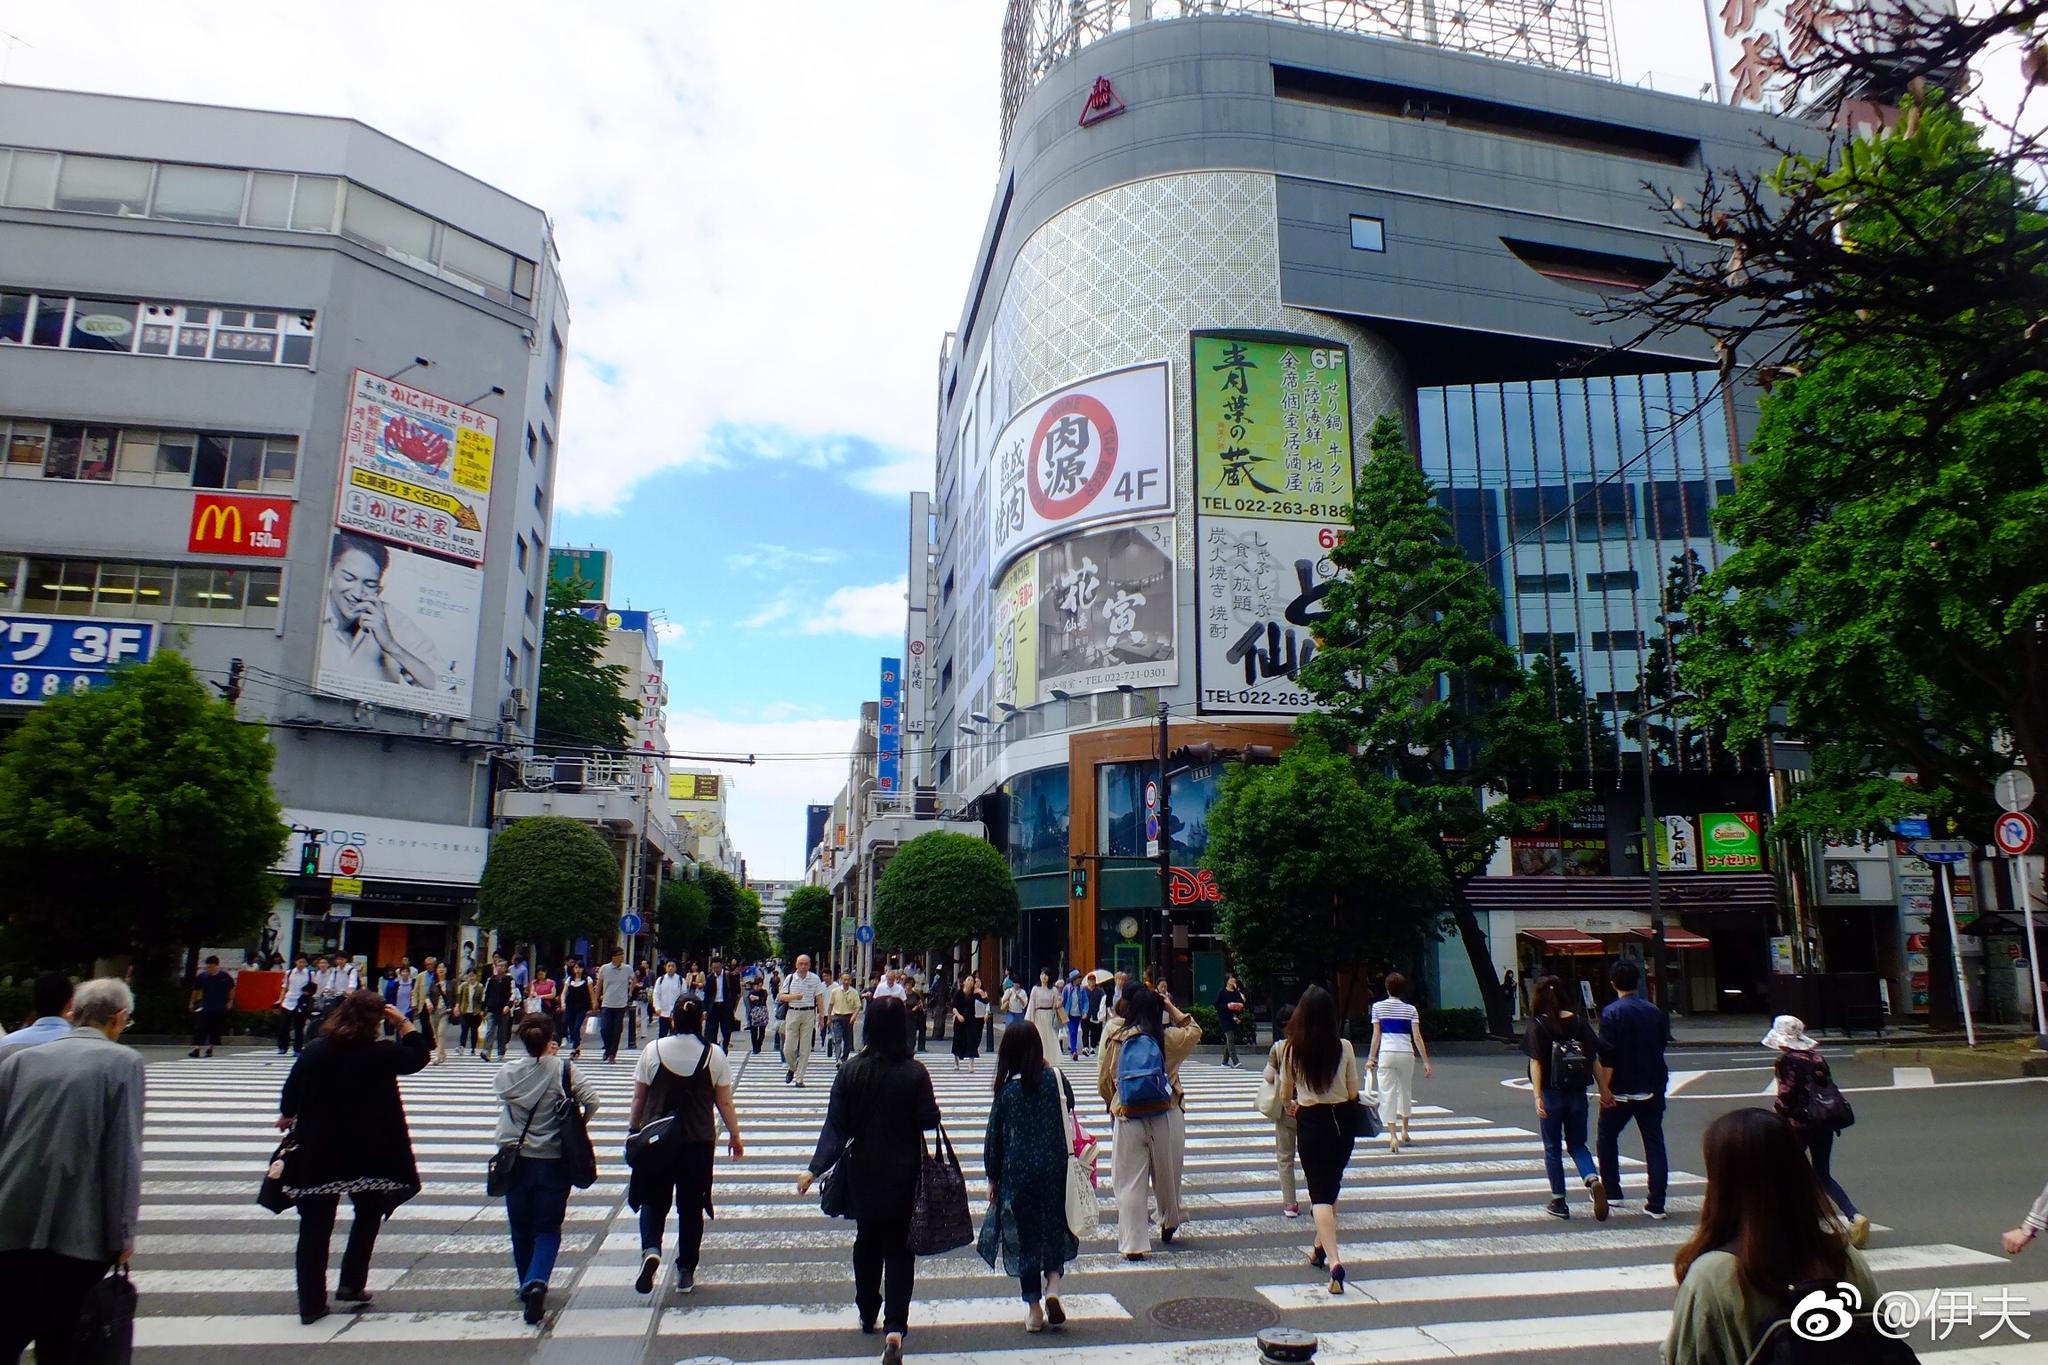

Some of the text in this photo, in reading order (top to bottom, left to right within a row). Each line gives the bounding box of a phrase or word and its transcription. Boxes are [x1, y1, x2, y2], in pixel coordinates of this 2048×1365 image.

[1310, 349, 1343, 370] 6F
[1212, 343, 1285, 495] 青葉の蔵
[1280, 349, 1303, 492] 全席個室居酒屋
[1303, 370, 1325, 494] 三陸海鮮 地酒
[1324, 381, 1344, 495] せり鍋 牛タン
[1044, 416, 1090, 498] 肉源
[1114, 468, 1158, 502] 4F
[370, 500, 447, 535] かに本家
[1202, 496, 1348, 518] TEL 022-263-8188
[249, 531, 282, 549] 150m
[1151, 525, 1171, 547] 3F
[1207, 528, 1230, 640] 炭火焼き 焼酎
[1232, 542, 1252, 612] 食べ放題
[1254, 530, 1272, 618] しゃぶしゃぶ
[69, 626, 143, 664] 3F
[1105, 668, 1166, 683] 022-721-0301
[1205, 690, 1236, 703] TEL
[909, 720, 923, 729] 4F
[1707, 854, 1759, 867] サイゼリヤ
